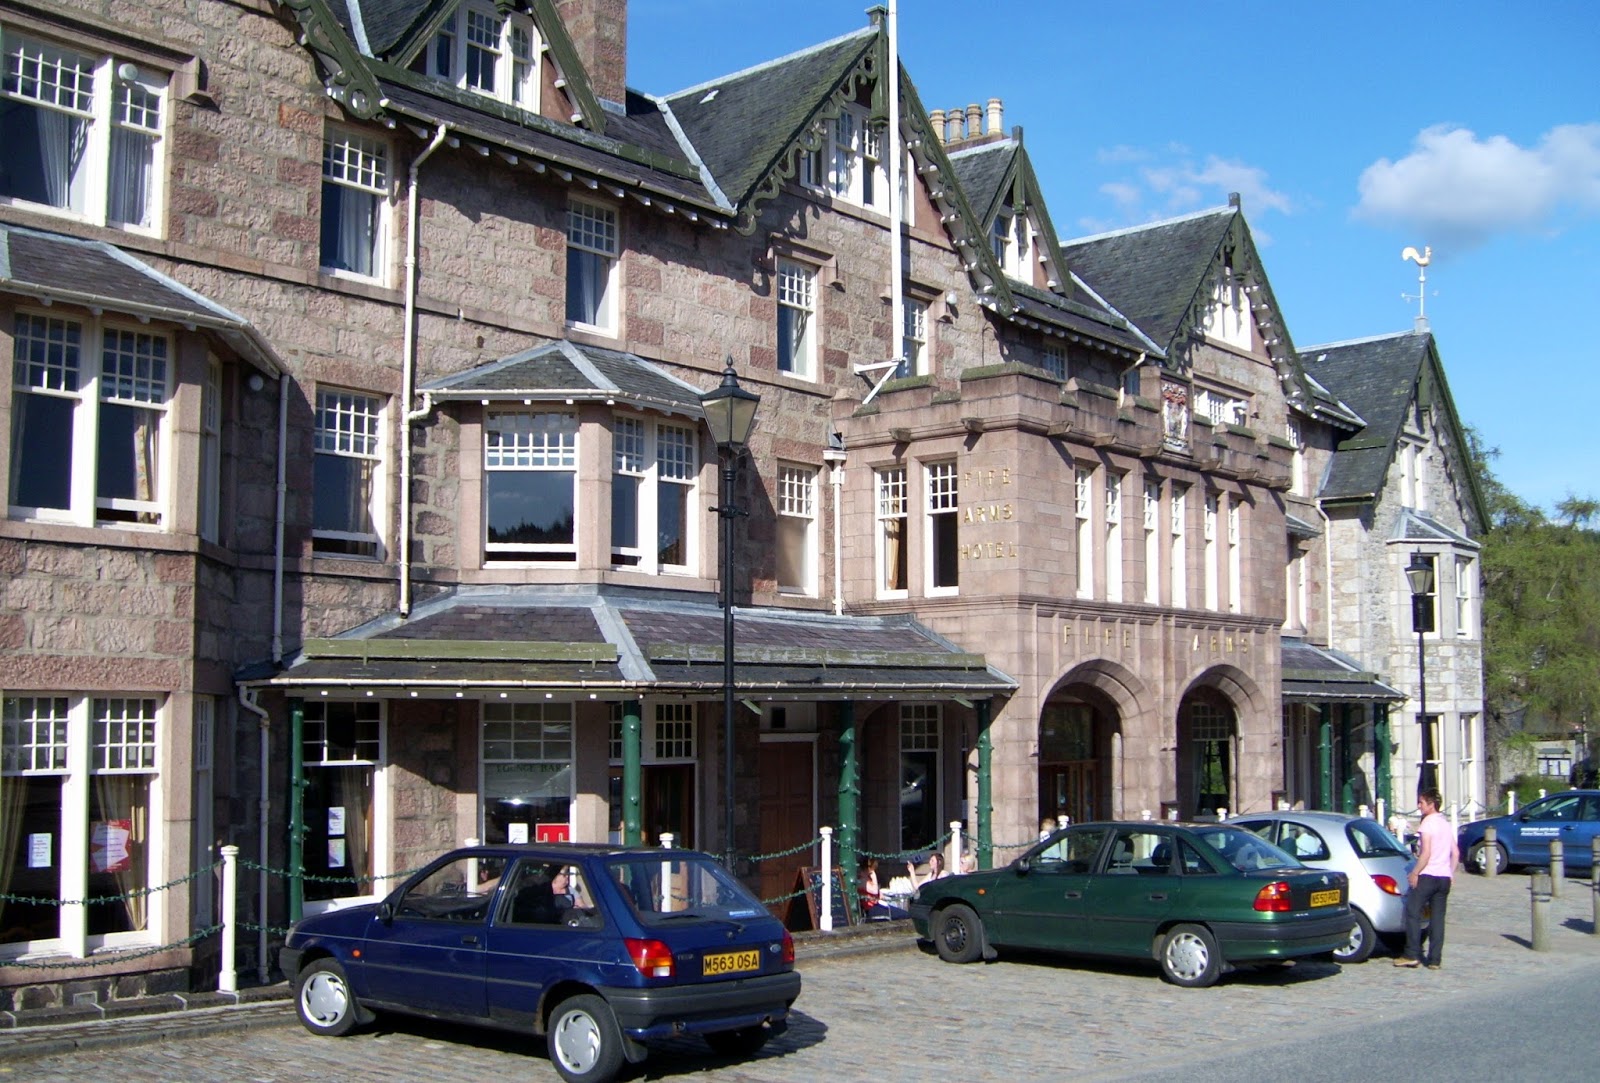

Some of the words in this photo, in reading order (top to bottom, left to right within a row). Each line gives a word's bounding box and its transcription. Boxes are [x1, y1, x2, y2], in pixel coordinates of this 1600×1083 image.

[964, 468, 1012, 487] FIFE
[963, 504, 1013, 523] ARMS
[961, 541, 1017, 560] HOTEL
[1063, 625, 1131, 648] FIFE
[1193, 634, 1248, 654] ARMS
[704, 955, 735, 973] M563
